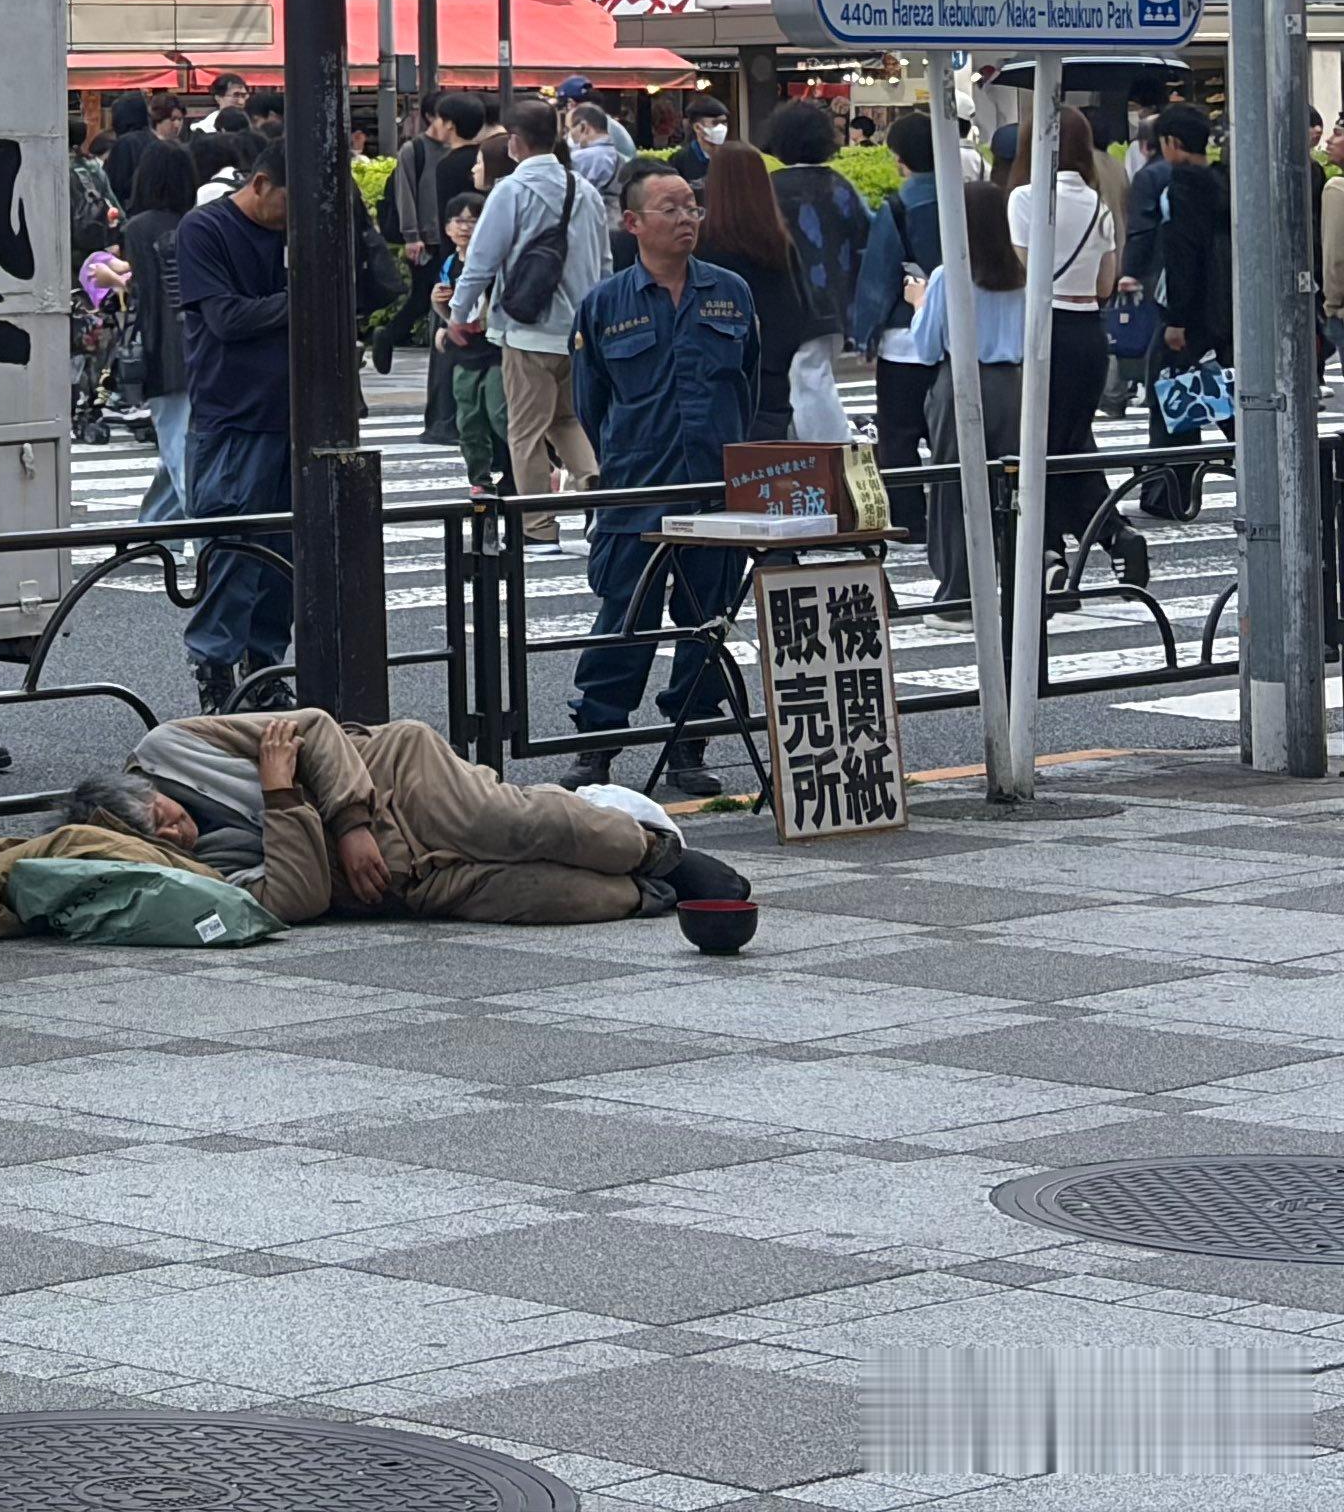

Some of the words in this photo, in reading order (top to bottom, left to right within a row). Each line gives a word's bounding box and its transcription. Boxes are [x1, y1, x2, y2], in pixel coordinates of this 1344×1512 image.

[840, 2, 888, 27] 440m
[1107, 2, 1134, 29] Park
[767, 585, 842, 831] 販売所
[825, 582, 898, 826] 機関紙
